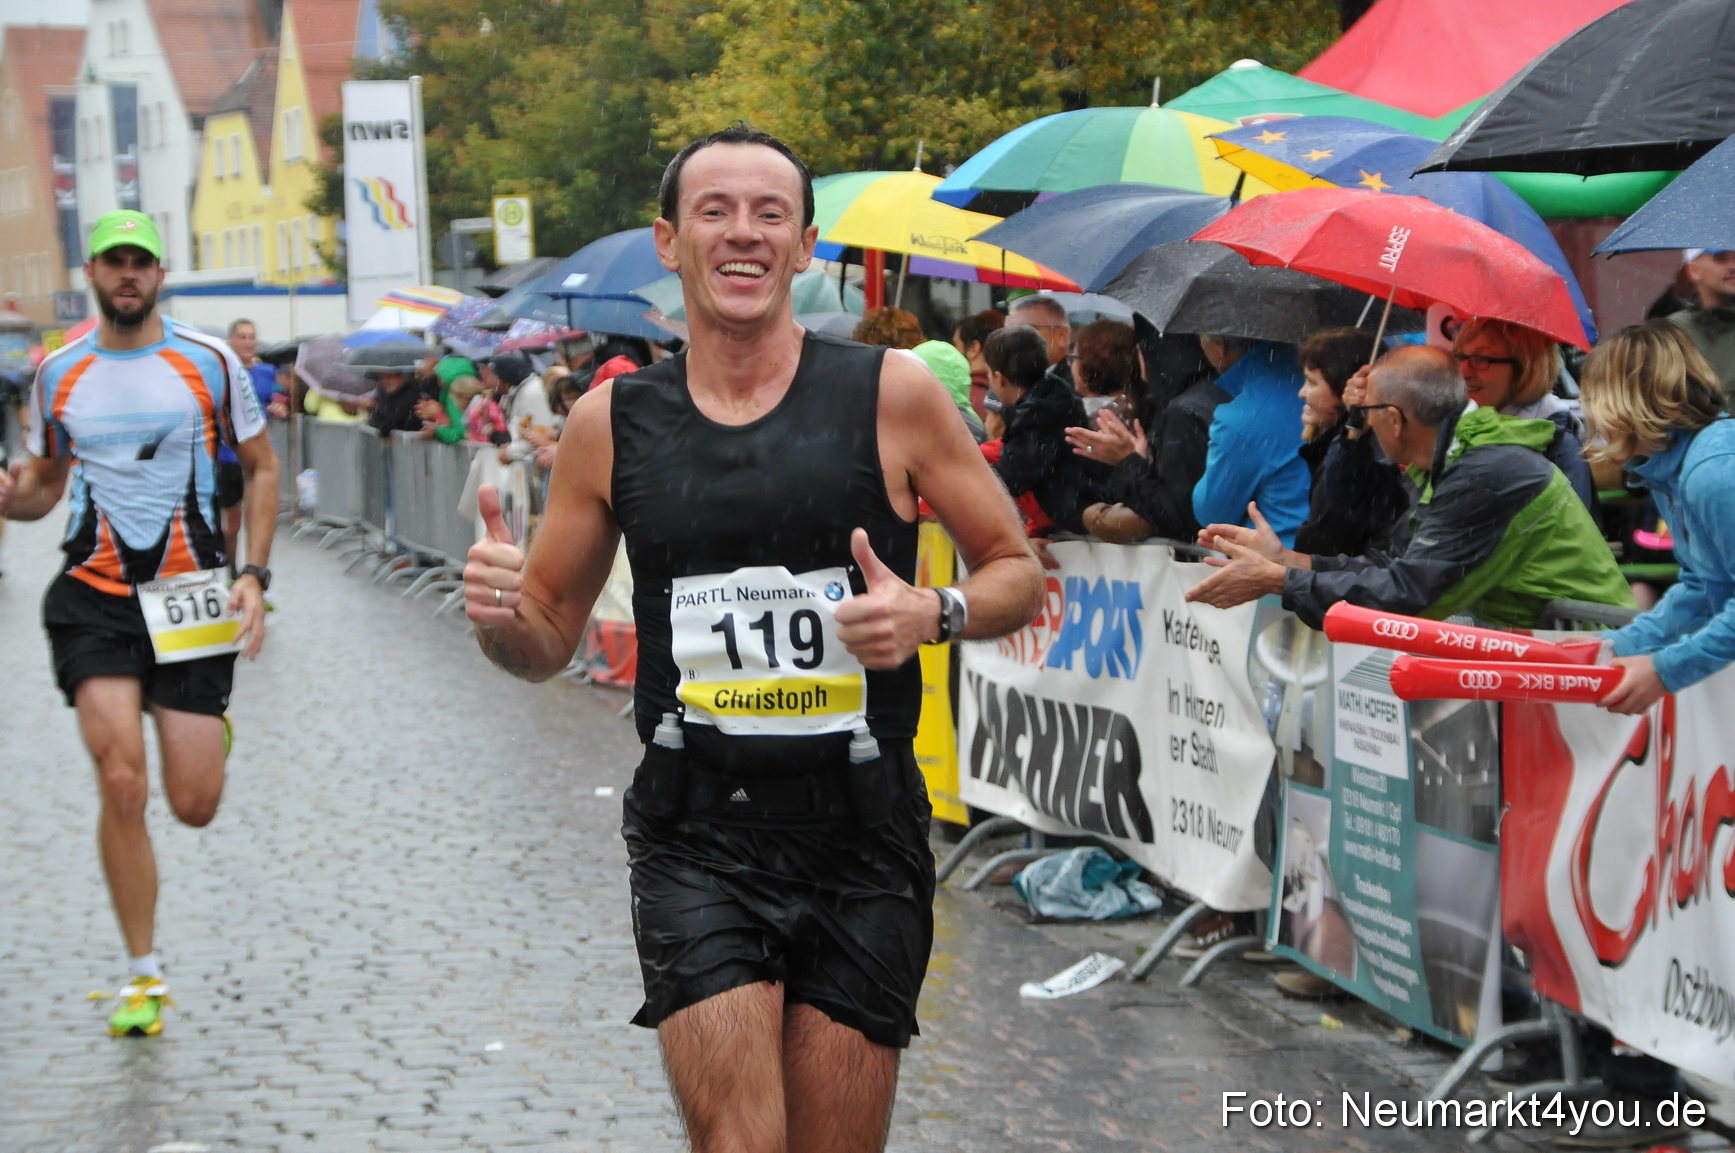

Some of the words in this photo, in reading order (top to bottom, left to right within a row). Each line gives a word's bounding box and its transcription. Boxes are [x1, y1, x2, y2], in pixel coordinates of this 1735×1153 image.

[1378, 225, 1411, 273] ESPRIT
[162, 587, 221, 624] 616
[675, 587, 731, 609] PARTL
[710, 608, 825, 670] 119
[1435, 629, 1477, 650] BKK
[1481, 636, 1530, 657] Audi
[688, 671, 696, 681] B
[1517, 672, 1555, 690] BKK
[1560, 674, 1603, 692] Audi
[714, 684, 828, 714] Christoph
